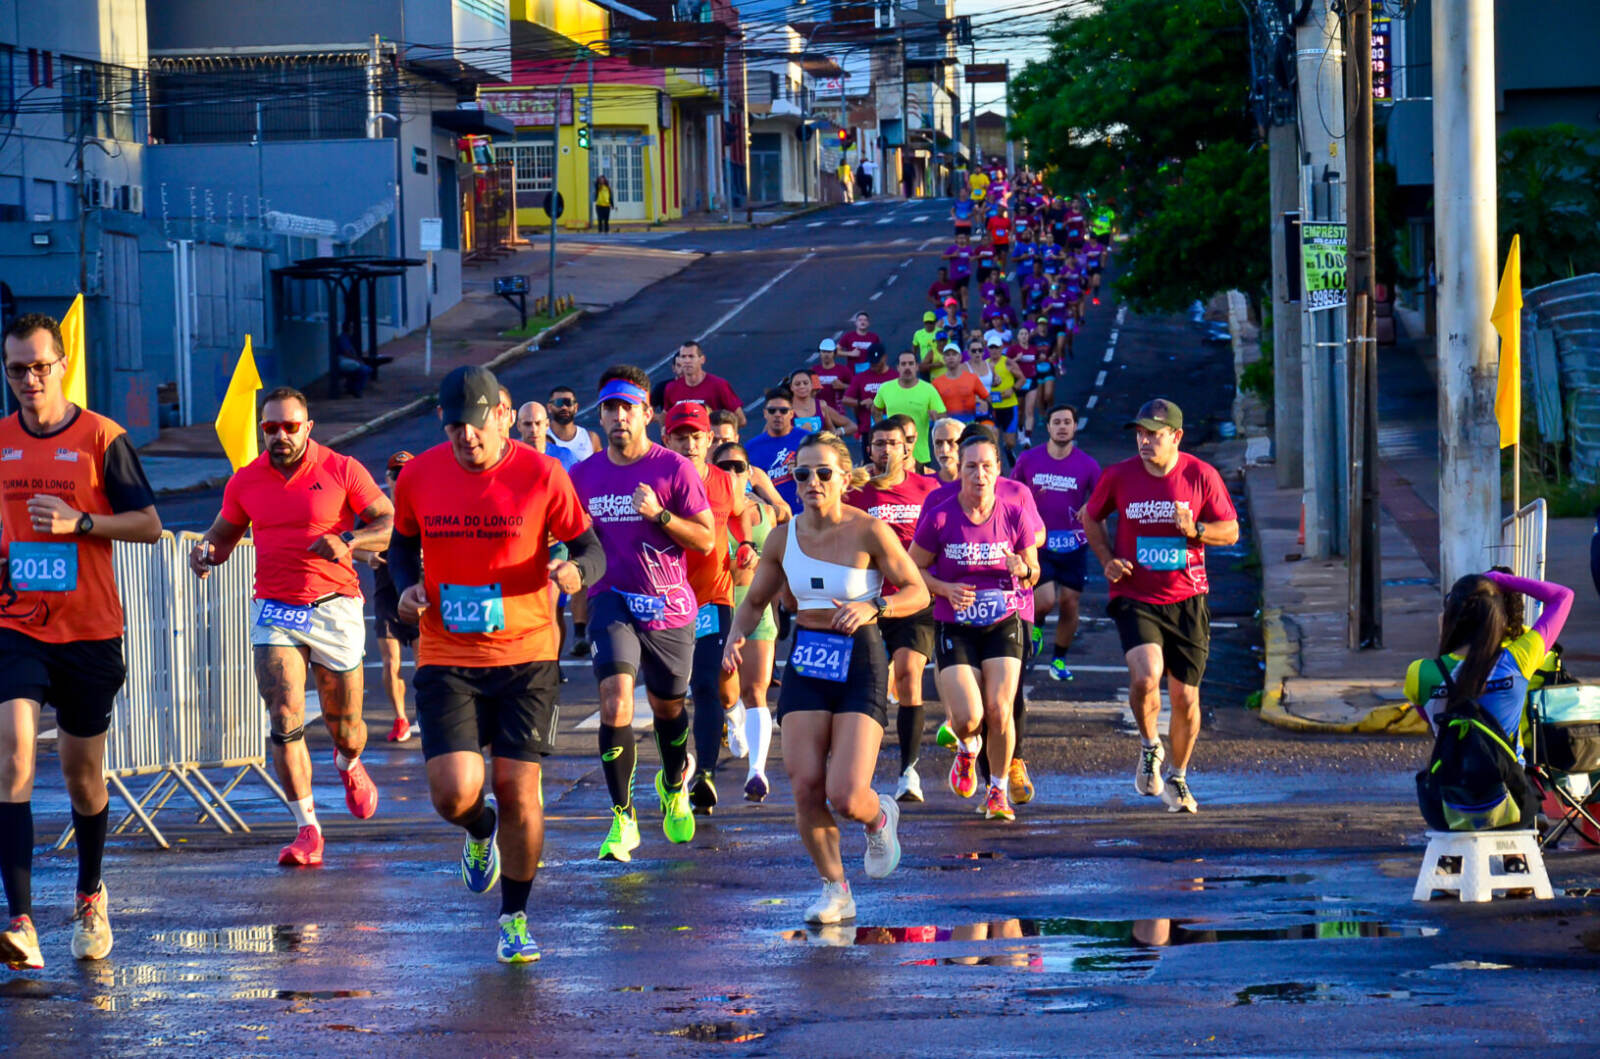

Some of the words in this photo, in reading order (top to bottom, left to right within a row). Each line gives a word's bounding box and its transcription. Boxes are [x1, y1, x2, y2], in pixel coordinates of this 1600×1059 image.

[31, 480, 43, 489] DO
[45, 480, 76, 490] LONGO
[424, 515, 460, 527] TURMA
[464, 515, 481, 526] DO
[483, 515, 523, 527] LONGO
[1048, 537, 1076, 549] 5138
[1138, 548, 1179, 563] 2003
[11, 558, 67, 580] 2018
[262, 604, 308, 624] 5189
[442, 600, 493, 622] 2127
[792, 645, 840, 670] 5124
